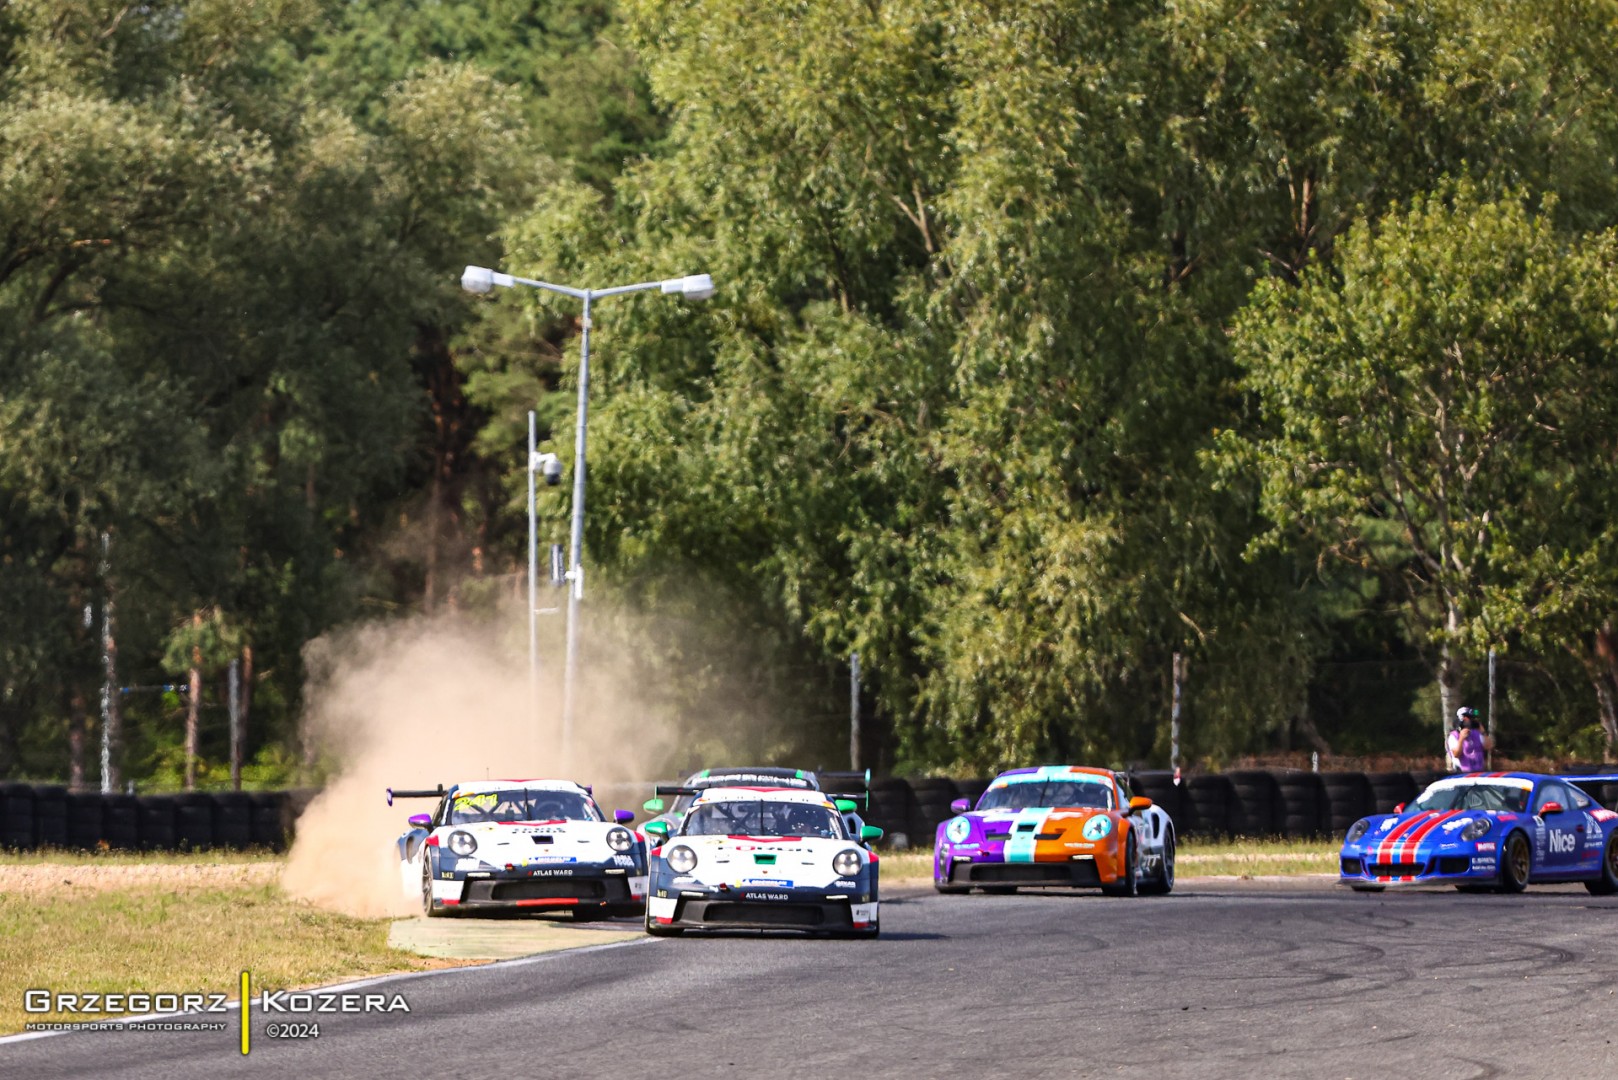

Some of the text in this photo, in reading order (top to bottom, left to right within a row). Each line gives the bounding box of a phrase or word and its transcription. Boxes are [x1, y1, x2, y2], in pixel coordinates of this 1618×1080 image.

[454, 793, 498, 811] 241
[1549, 829, 1576, 853] Nice
[745, 892, 789, 901] ATLAS WARD
